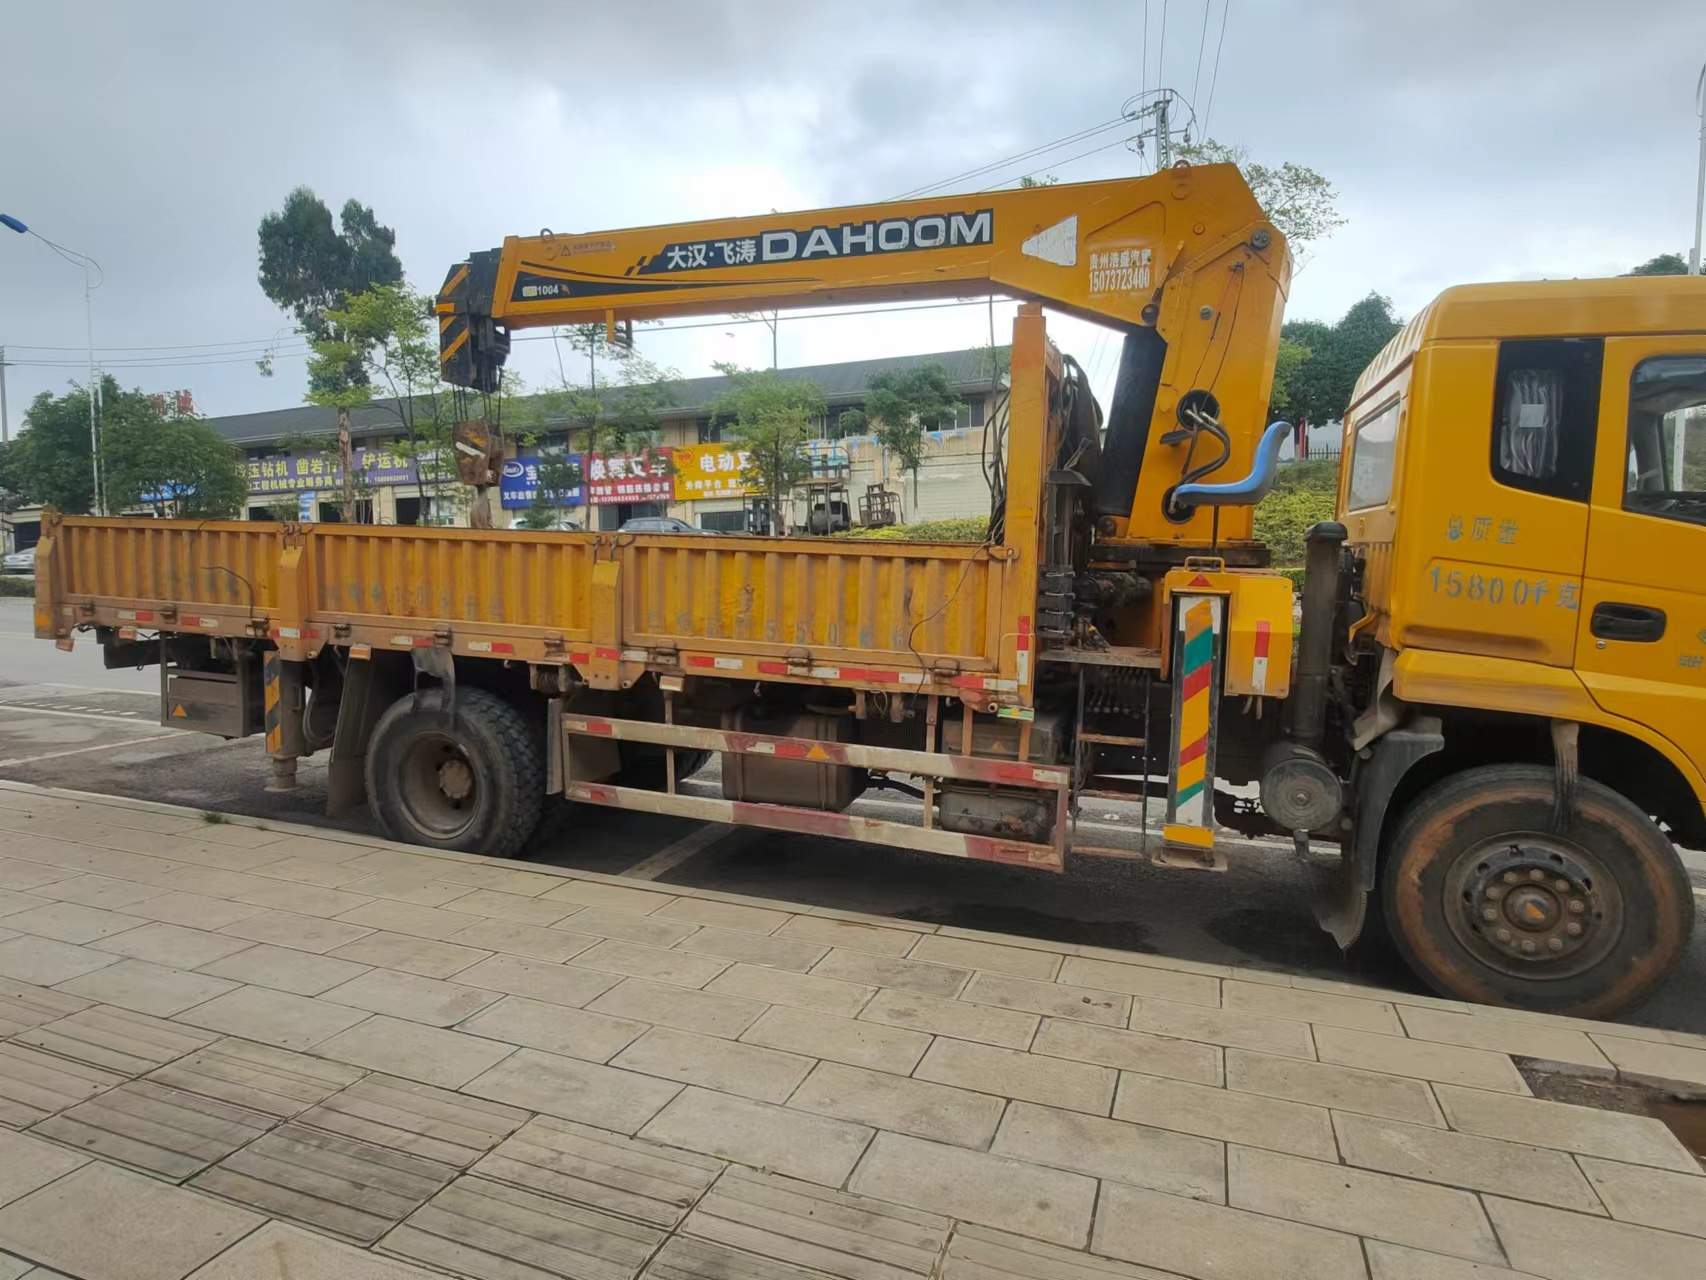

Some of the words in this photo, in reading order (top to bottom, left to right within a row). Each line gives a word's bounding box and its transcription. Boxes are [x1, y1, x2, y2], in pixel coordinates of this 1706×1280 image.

[762, 212, 992, 262] DAHOOM
[667, 239, 756, 269] 大汉·飞涛
[536, 284, 559, 297] 1004
